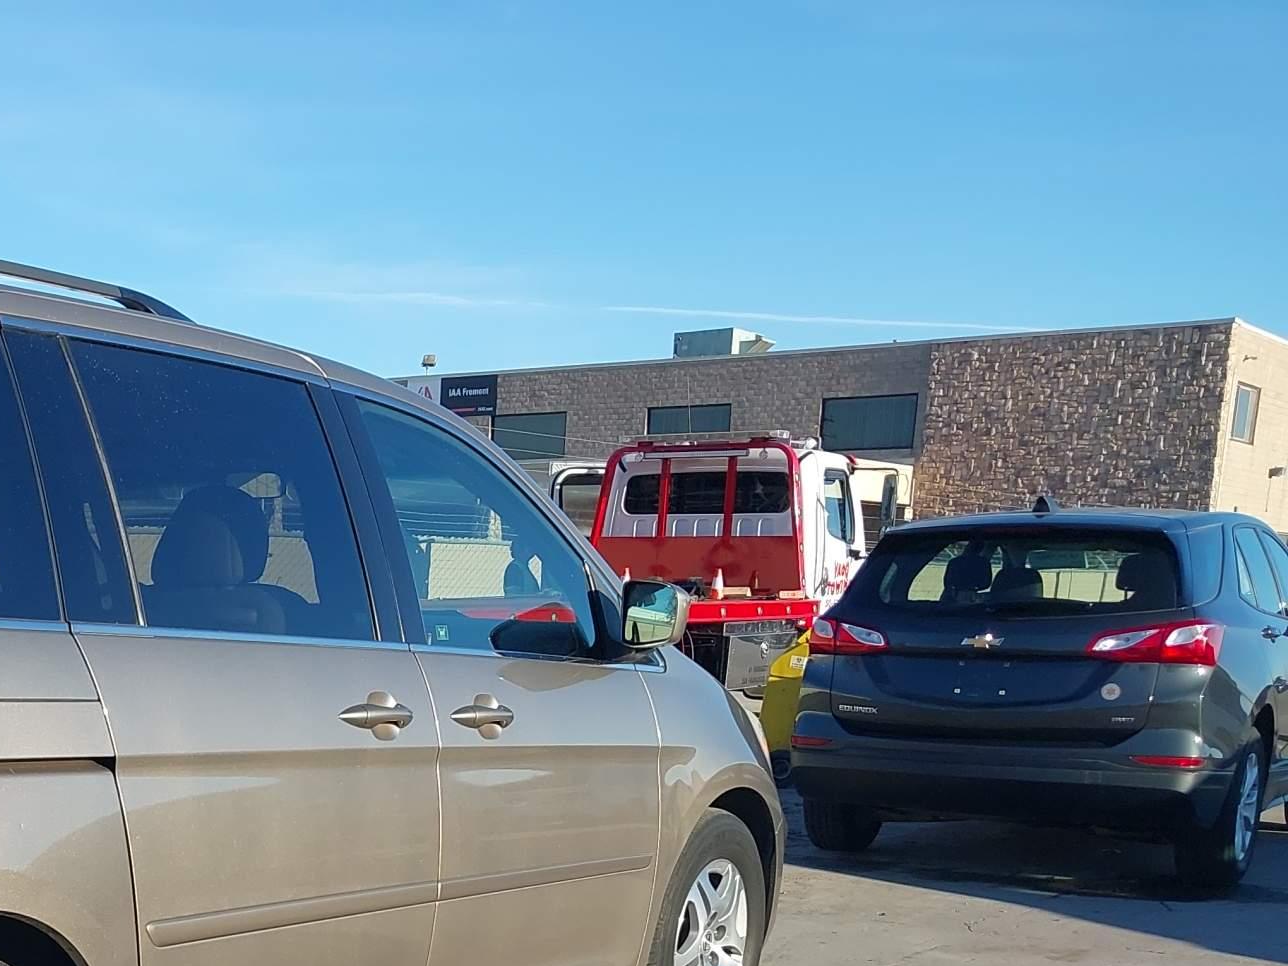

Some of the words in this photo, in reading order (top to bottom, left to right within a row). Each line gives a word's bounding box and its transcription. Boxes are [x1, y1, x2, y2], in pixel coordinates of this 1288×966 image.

[448, 387, 462, 397] IAA
[462, 387, 489, 397] Fremont
[838, 704, 879, 715] EQUINOX
